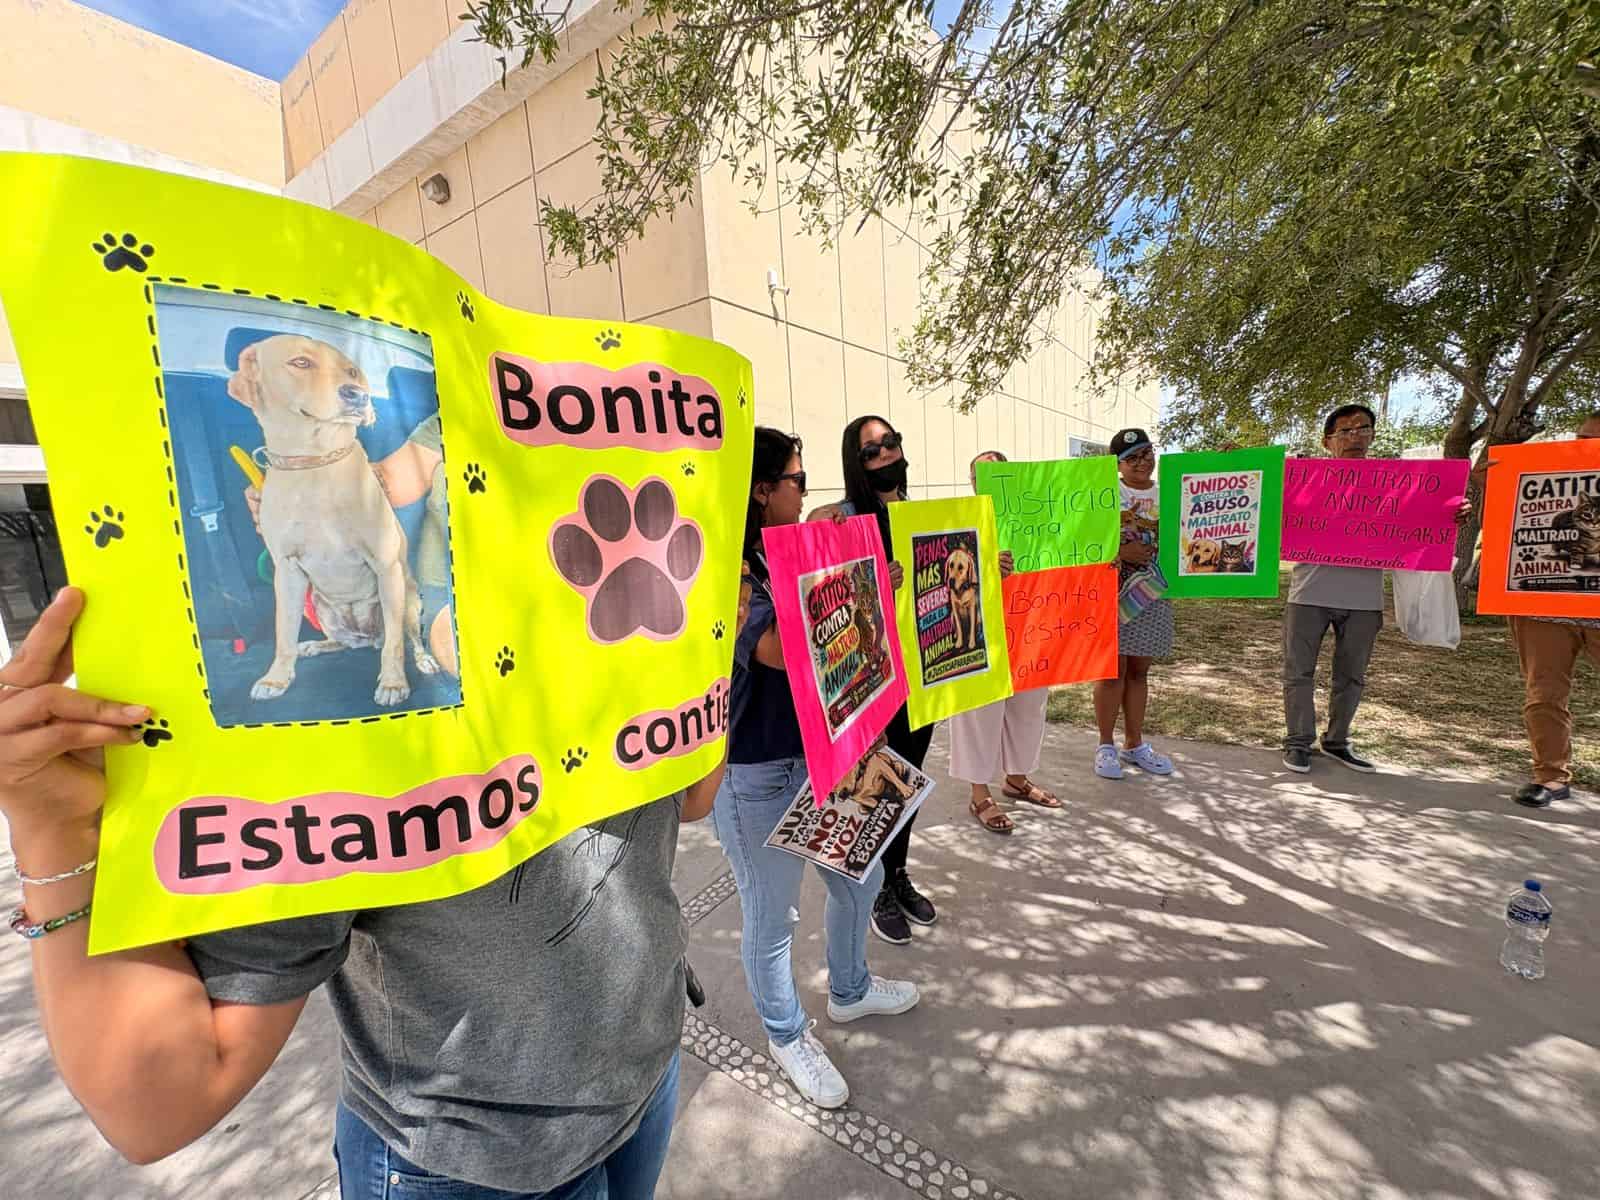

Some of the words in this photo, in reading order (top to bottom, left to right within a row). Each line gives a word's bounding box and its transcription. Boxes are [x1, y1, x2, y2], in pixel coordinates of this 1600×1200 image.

[497, 356, 721, 442] Bonita
[1190, 475, 1249, 495] UNIDOS
[1324, 466, 1441, 494] MALTRATO
[1522, 475, 1600, 500] GATIT
[991, 474, 1116, 518] Justicia
[1190, 495, 1250, 516] ABUSO
[1324, 492, 1400, 517] ANIMAL
[1519, 498, 1574, 515] CONTRA
[1187, 511, 1251, 529] MALTRATO
[1192, 522, 1250, 540] ANIMAL
[1530, 518, 1544, 527] EL
[1517, 529, 1580, 543] MALTRATO
[916, 536, 949, 568] PENAS
[1016, 540, 1104, 572] onita
[1514, 562, 1571, 576] ANIMAL
[808, 574, 850, 618] GATITOS
[918, 588, 949, 616] SEVERAS
[1008, 586, 1099, 614] Bonita
[816, 609, 850, 643] CONTRA
[924, 638, 955, 667] ANIMAL
[824, 654, 860, 698] ANIMAL
[178, 759, 540, 880] Estamos
[791, 810, 816, 844] PARA
[807, 808, 839, 853] NO
[857, 802, 901, 864] BONITA
[821, 815, 848, 856] TIENEN
[828, 815, 863, 860] VOZ
